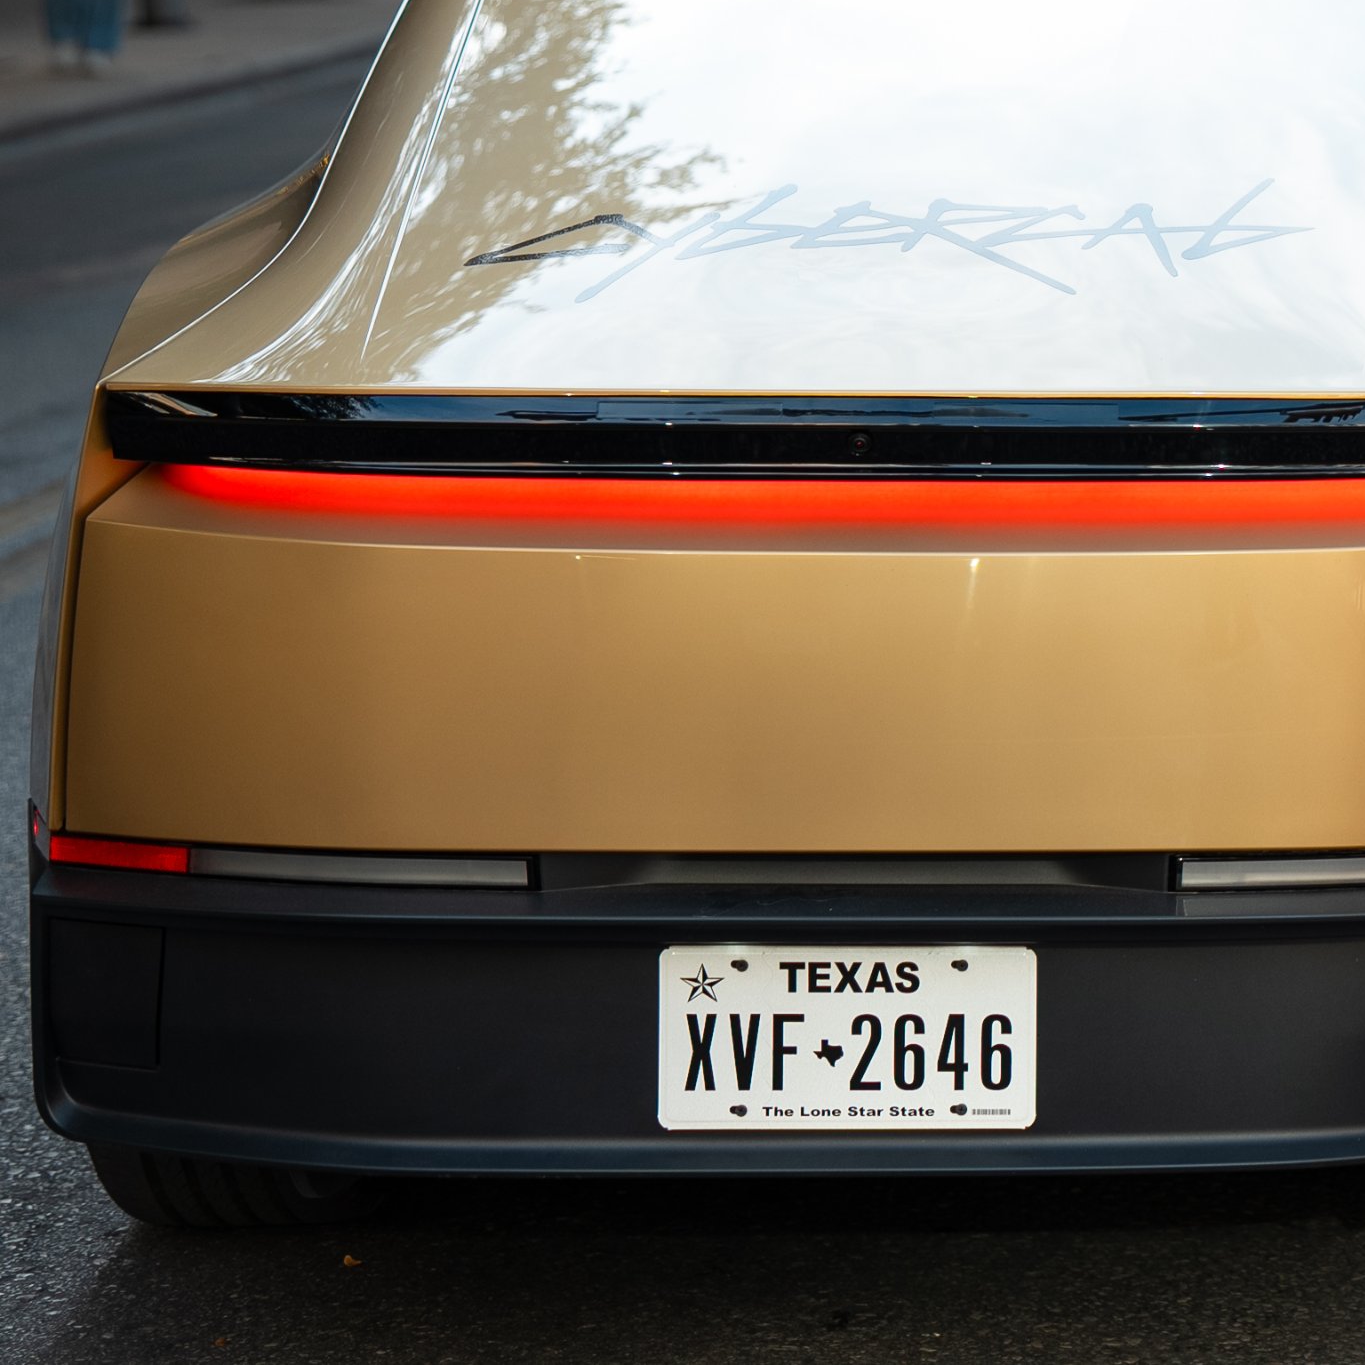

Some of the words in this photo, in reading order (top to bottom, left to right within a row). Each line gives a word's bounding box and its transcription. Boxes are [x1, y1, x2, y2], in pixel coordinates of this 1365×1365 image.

[780, 962, 920, 993] TEXAS
[685, 1014, 805, 1091] XVF
[850, 1014, 1013, 1091] 2646
[762, 1106, 794, 1117] The
[800, 1106, 841, 1117] Lone
[848, 1106, 884, 1117] Star
[889, 1106, 935, 1117] State
